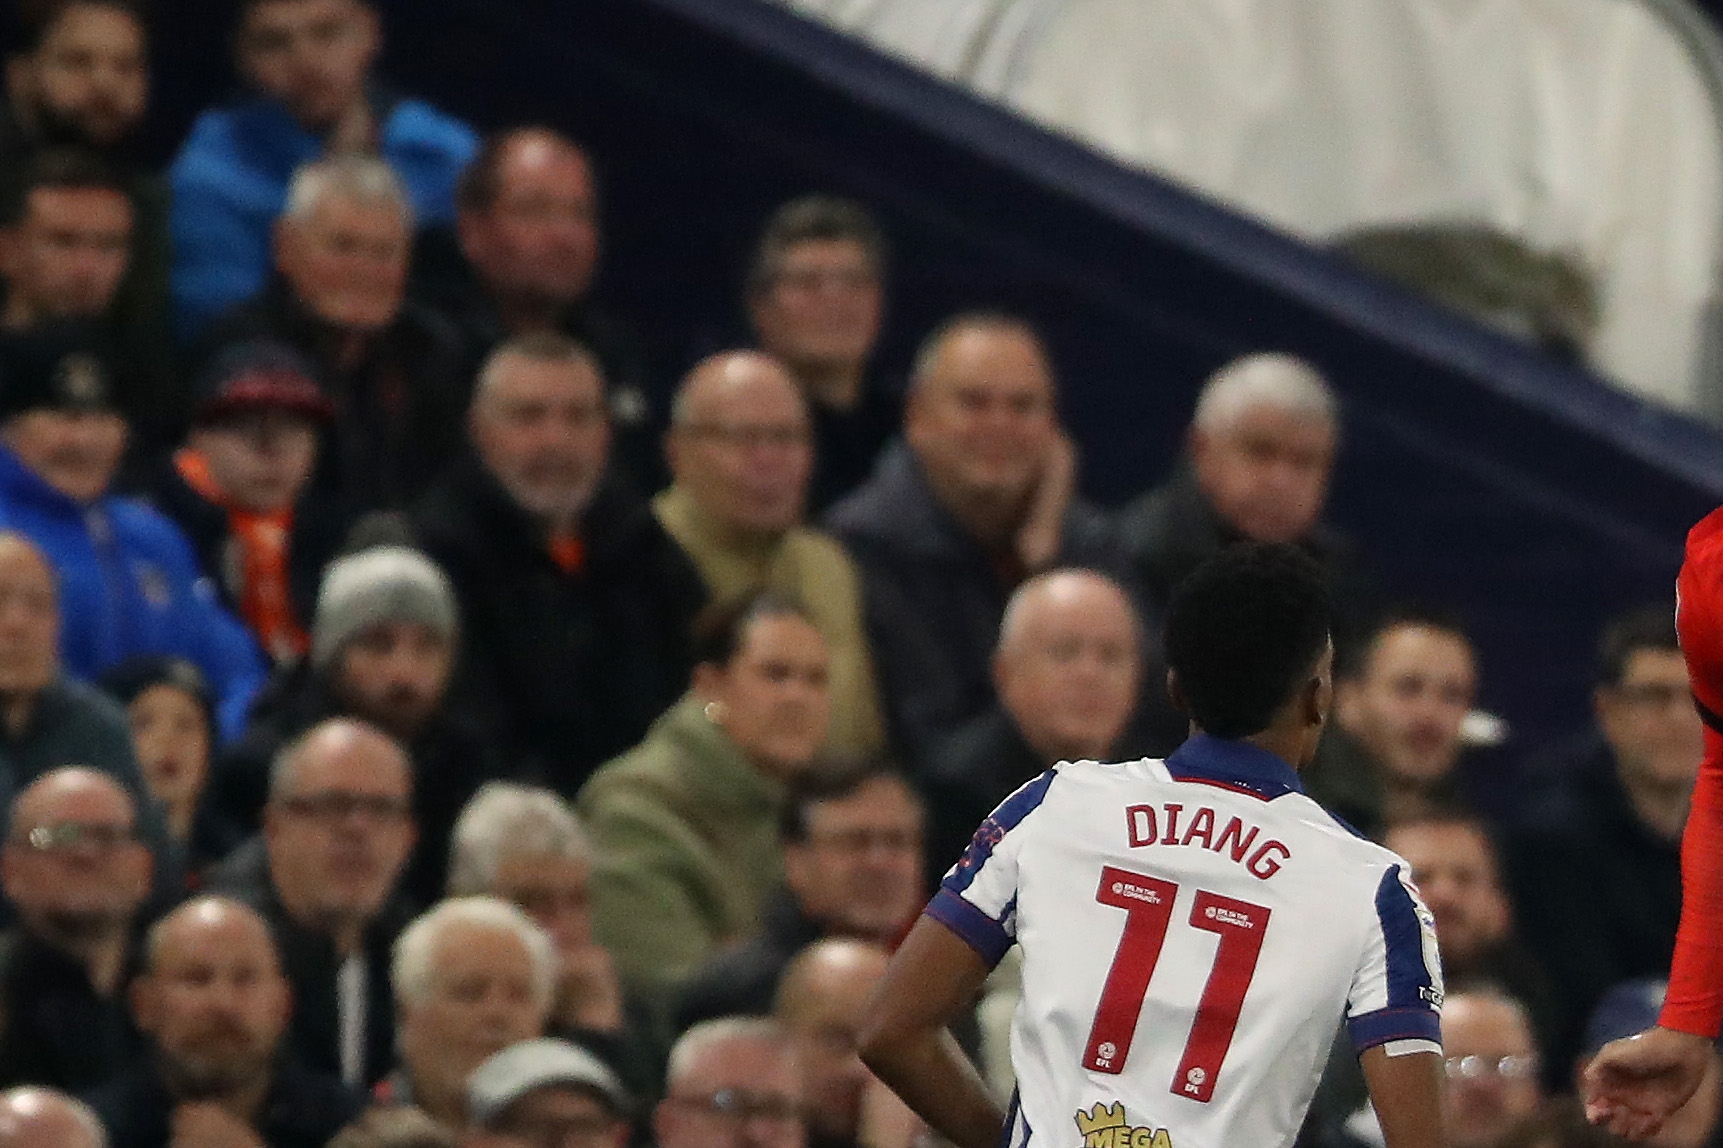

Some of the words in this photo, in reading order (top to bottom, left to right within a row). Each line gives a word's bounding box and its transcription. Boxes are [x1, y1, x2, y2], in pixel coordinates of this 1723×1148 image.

[1126, 803, 1291, 880] DIANG
[1081, 866, 1271, 1103] 11
[1096, 1057, 1111, 1068] EFL
[1184, 1083, 1199, 1095] EFL
